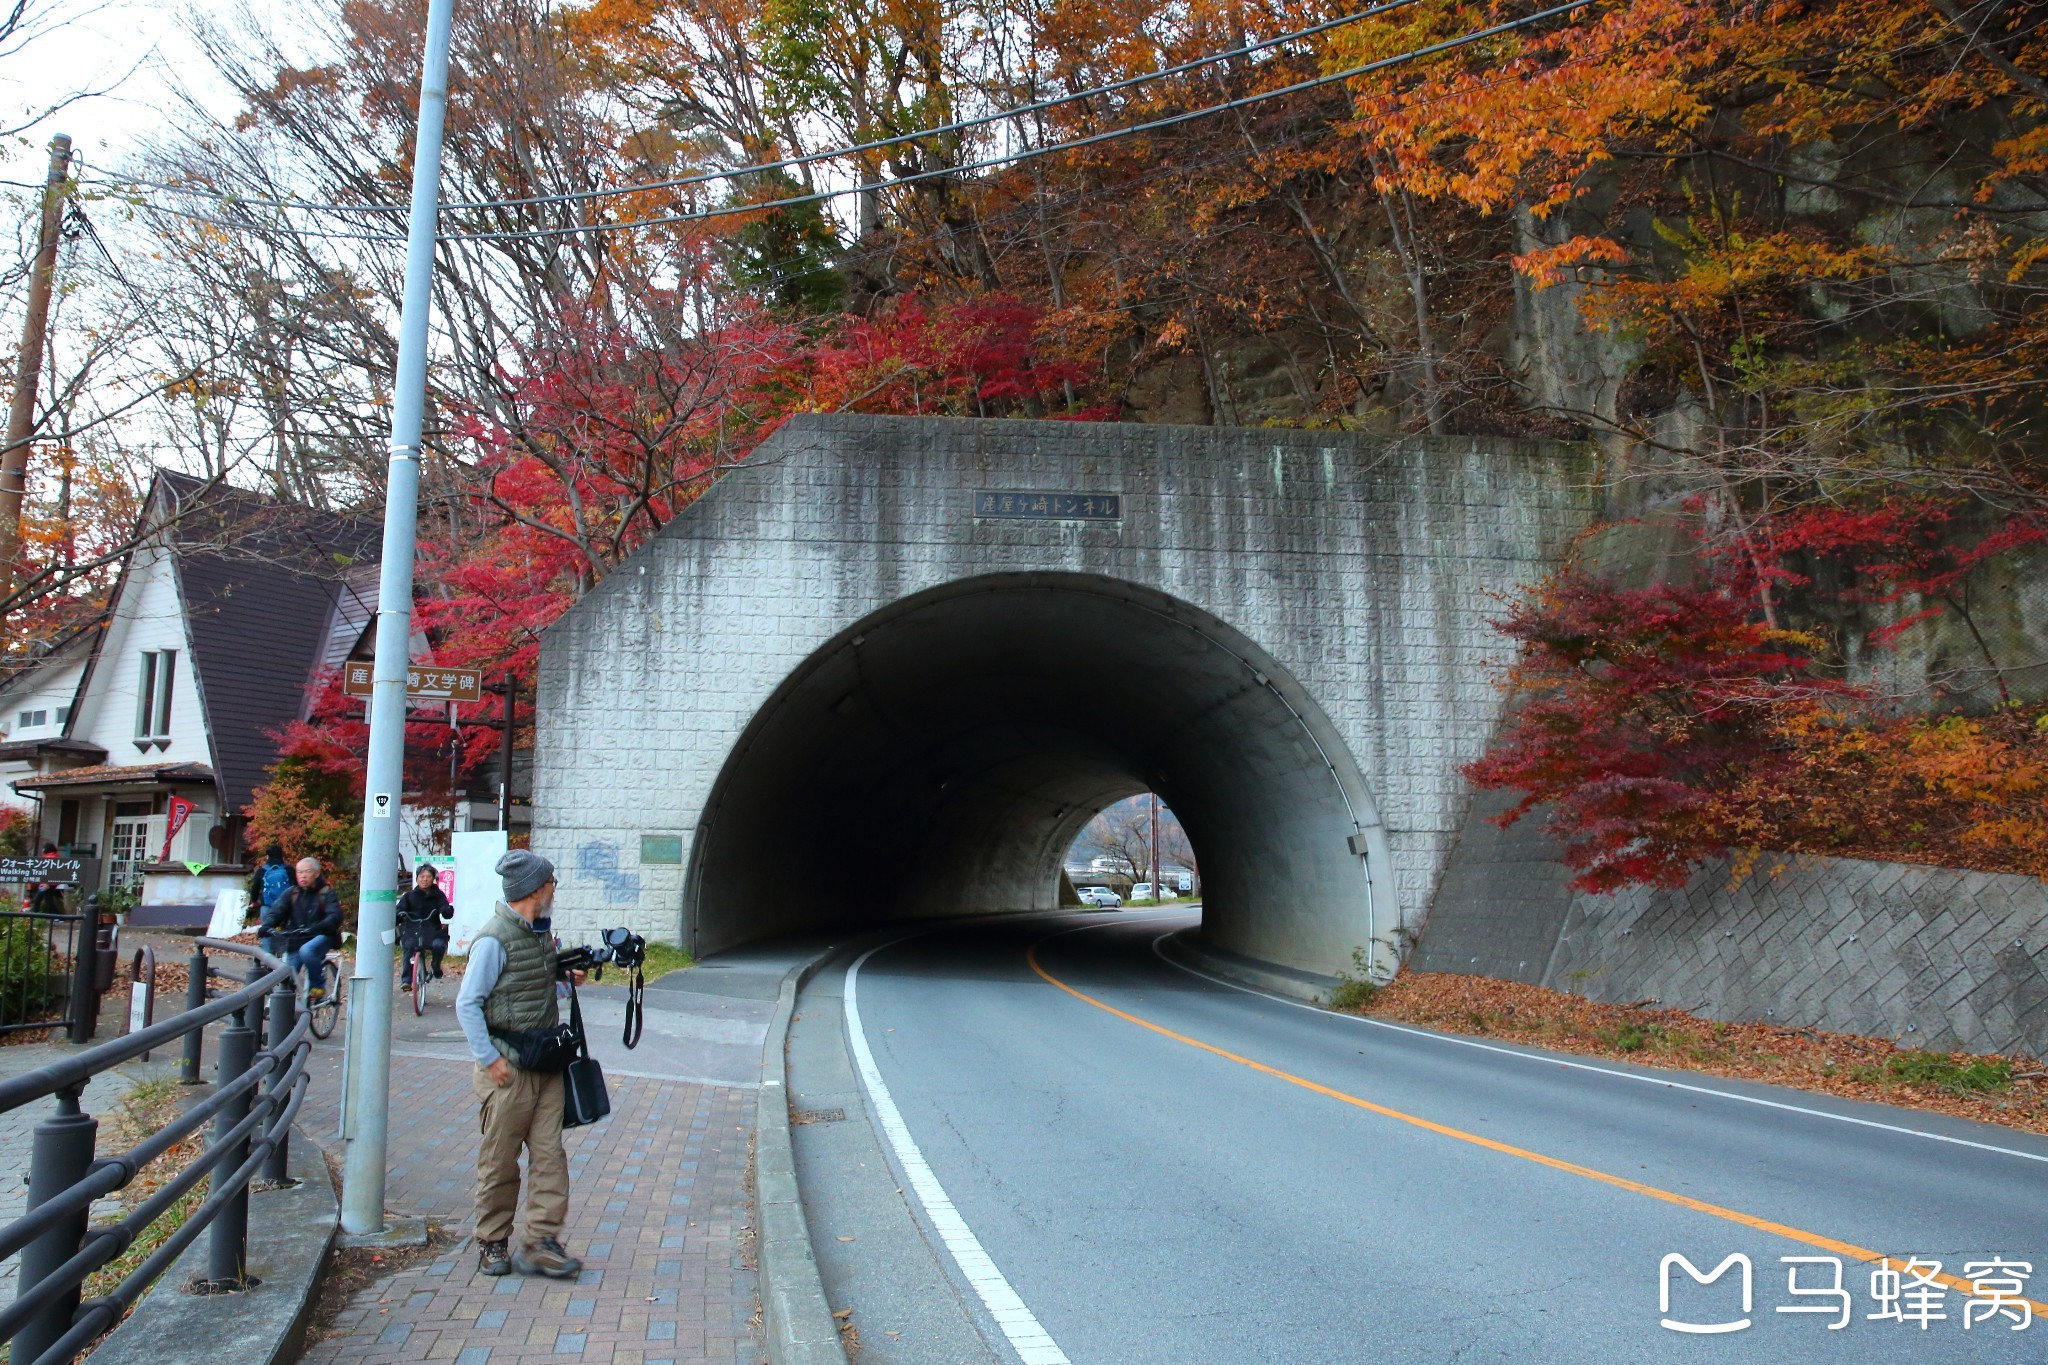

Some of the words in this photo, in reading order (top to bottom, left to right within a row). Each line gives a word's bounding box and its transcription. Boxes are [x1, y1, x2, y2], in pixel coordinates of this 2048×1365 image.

[351, 668, 475, 691] 産崎文学碑
[0, 868, 30, 876] Walking
